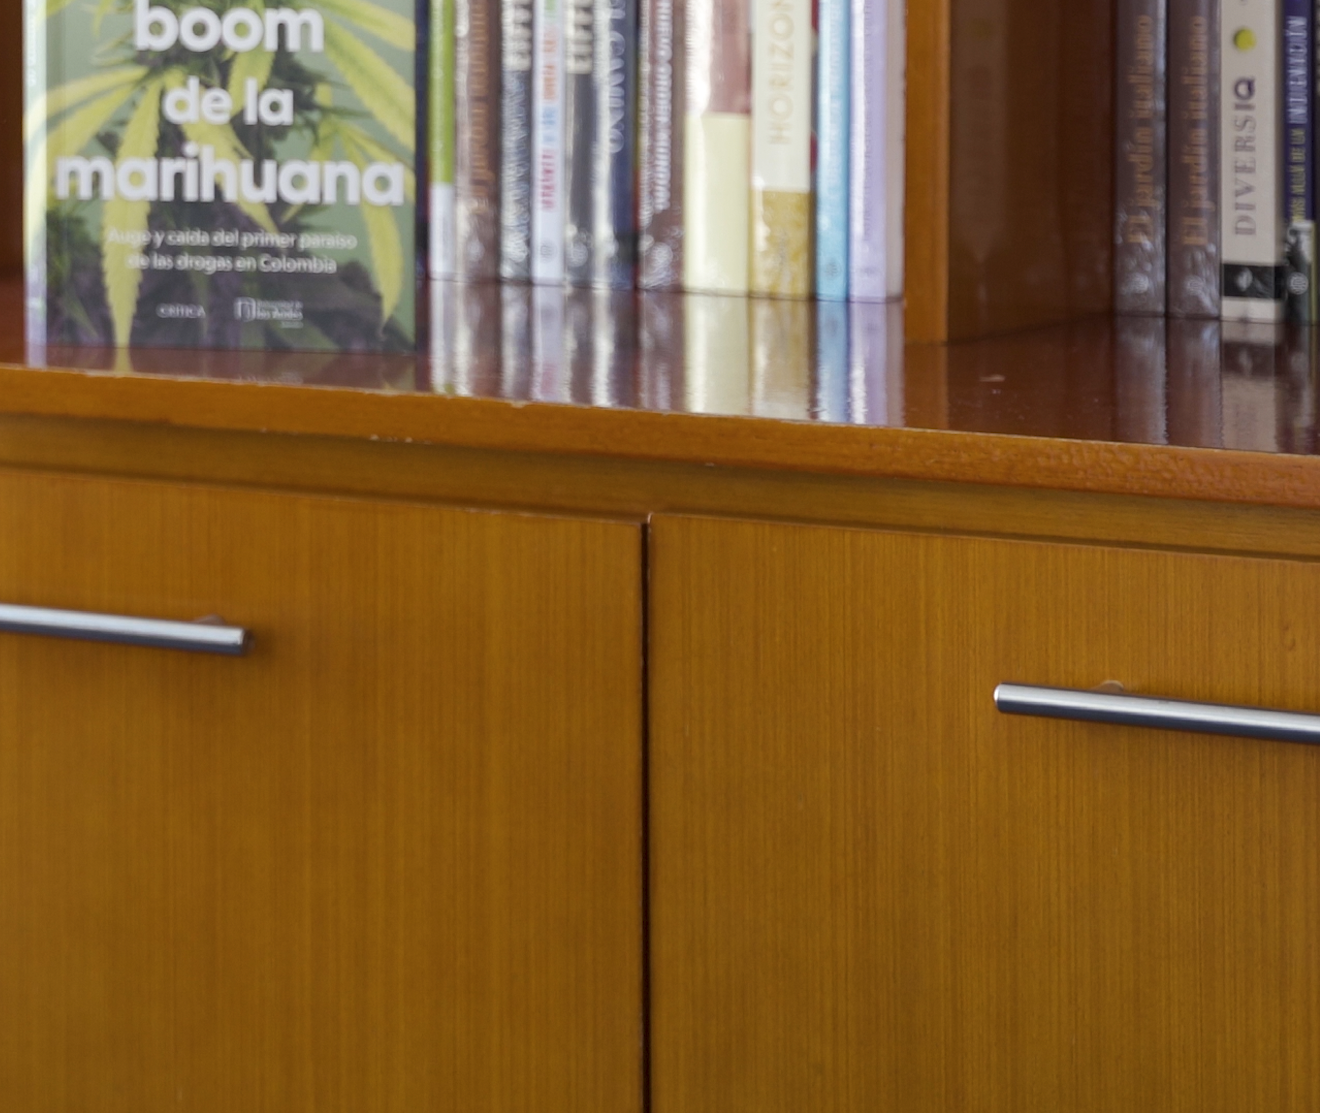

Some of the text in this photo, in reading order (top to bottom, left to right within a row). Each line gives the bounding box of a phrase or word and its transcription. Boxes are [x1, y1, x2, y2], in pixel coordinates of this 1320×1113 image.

[164, 77, 294, 126] de la
[55, 146, 404, 206] marihuana
[1233, 76, 1256, 237] DIVERSIQ
[153, 253, 173, 271] las
[176, 253, 233, 275] drogas
[260, 254, 337, 274] Colombia
[213, 229, 240, 248] del
[242, 229, 296, 250] primer
